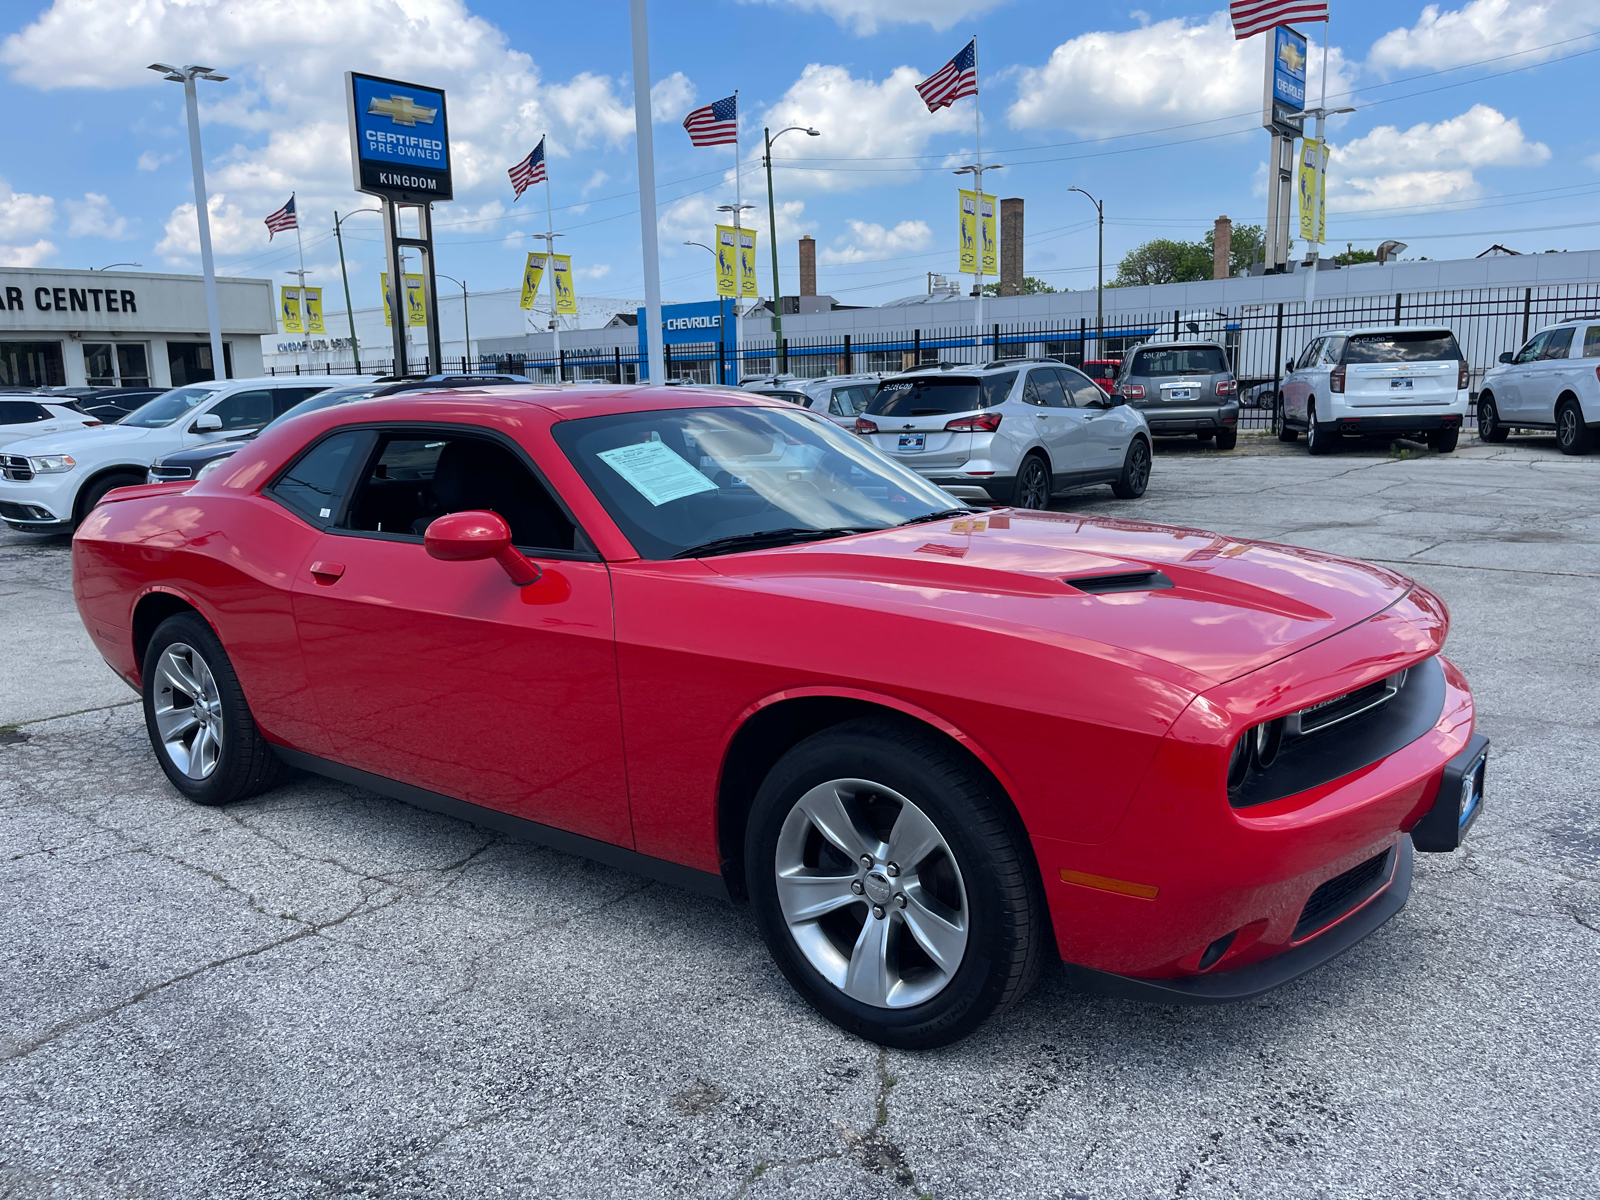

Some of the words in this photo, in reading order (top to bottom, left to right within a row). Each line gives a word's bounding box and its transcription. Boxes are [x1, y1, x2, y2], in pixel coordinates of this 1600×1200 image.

[1277, 78, 1304, 100] CHEVROLET
[366, 130, 442, 150] CERTIFIED
[370, 142, 440, 160] PRE-OWNED
[380, 172, 437, 190] KINGDOM
[720, 230, 734, 246] King
[530, 256, 546, 269] King
[0, 286, 24, 311] R
[34, 287, 137, 312] CENTER
